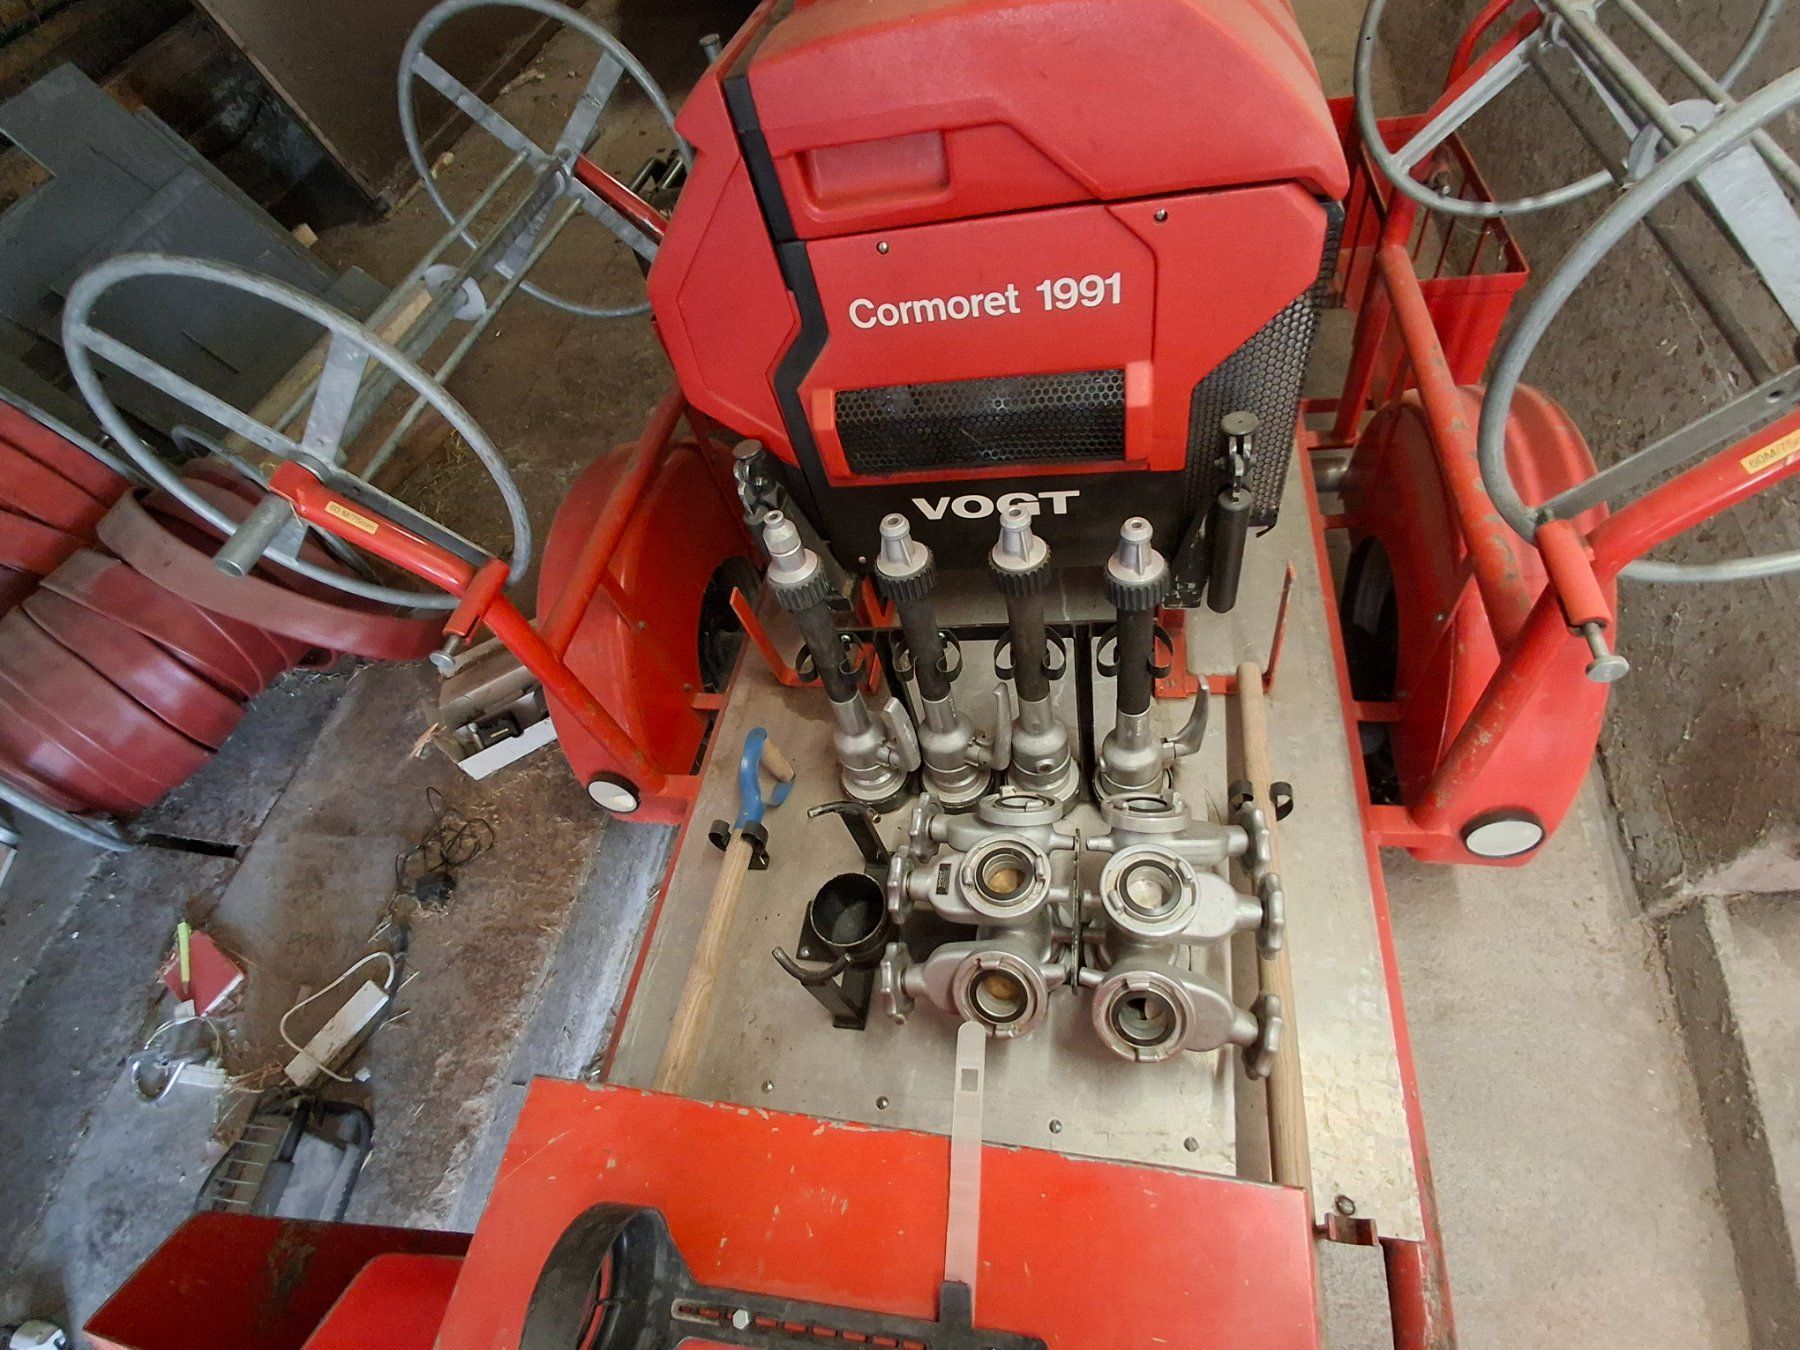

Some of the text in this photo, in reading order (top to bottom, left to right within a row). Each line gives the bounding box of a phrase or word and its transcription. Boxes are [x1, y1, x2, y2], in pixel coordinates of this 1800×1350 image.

[849, 272, 1121, 329] Cormoret 1991
[911, 490, 1080, 520] VOGT
